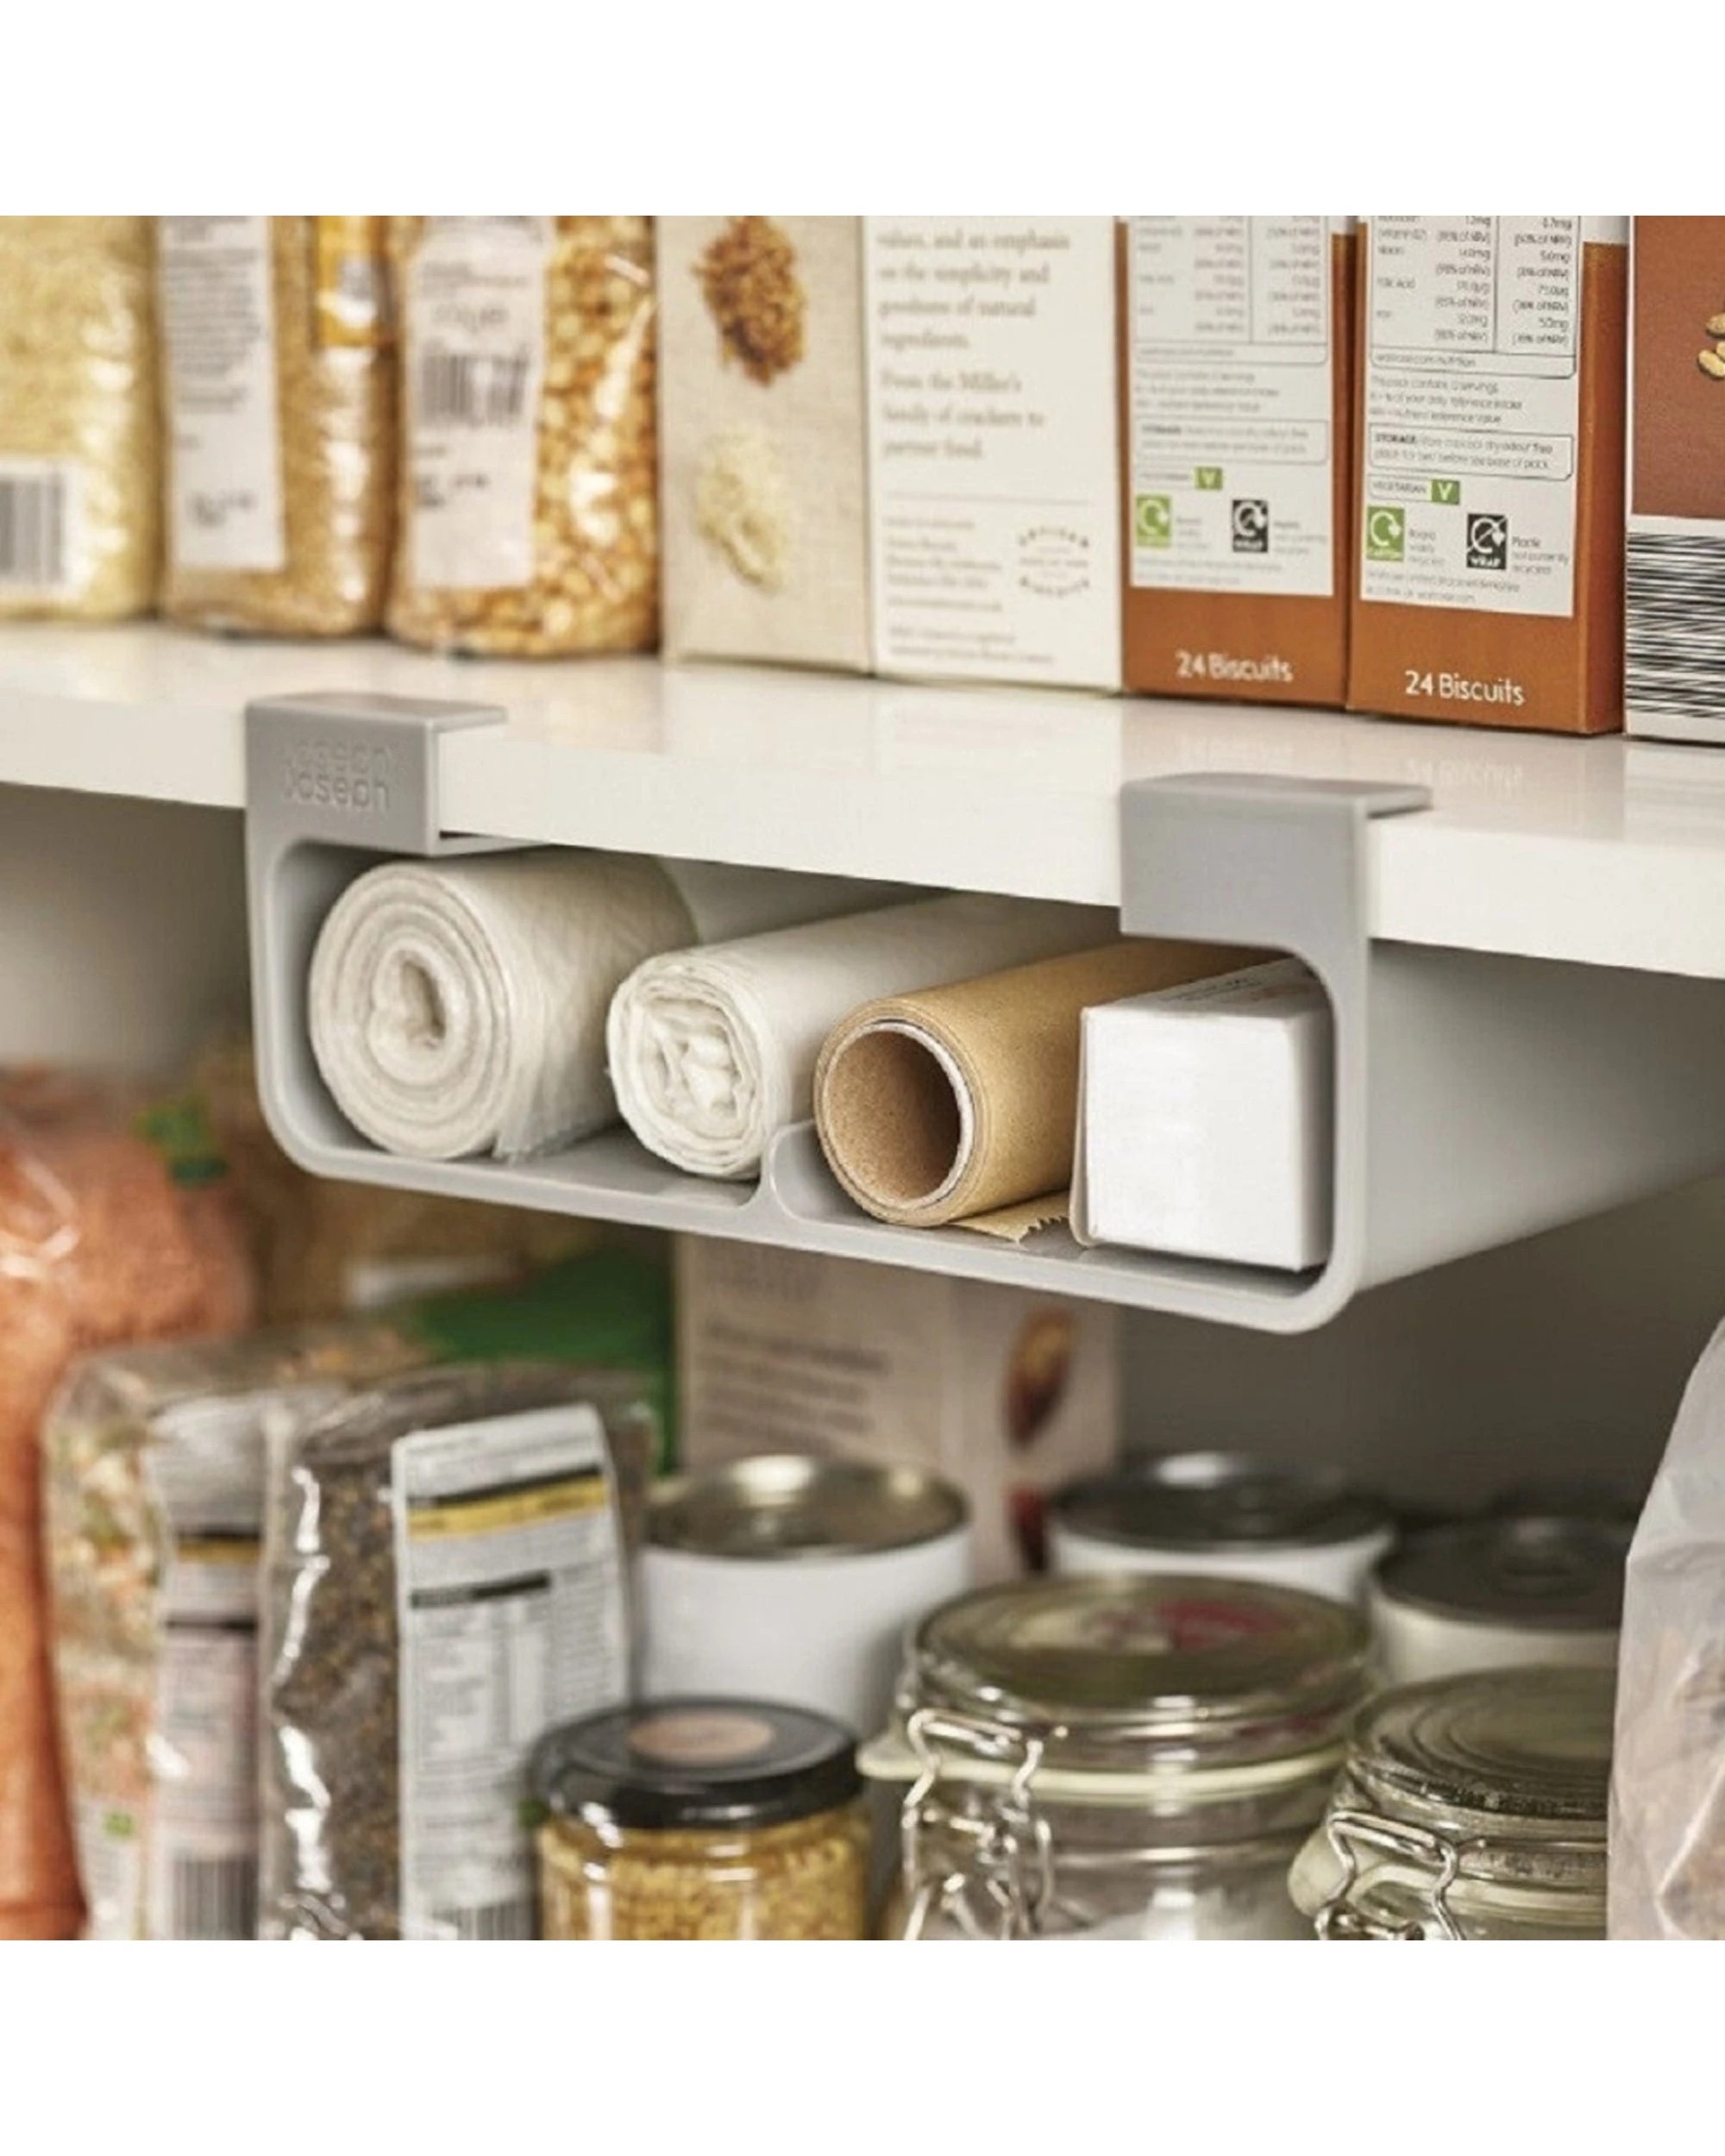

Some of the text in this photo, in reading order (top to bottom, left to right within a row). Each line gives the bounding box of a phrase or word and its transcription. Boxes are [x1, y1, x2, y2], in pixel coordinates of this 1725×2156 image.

[933, 229, 963, 249] and
[993, 228, 1070, 257] emphasis
[903, 261, 925, 281] the
[933, 261, 1012, 290] simplicity
[1019, 261, 1050, 283] and
[957, 293, 975, 315] of
[979, 295, 1037, 316] natural
[1176, 649, 1294, 683] 24 Biscuits
[1405, 670, 1526, 707] 24 Biscuits
[282, 763, 390, 813] Joseph
